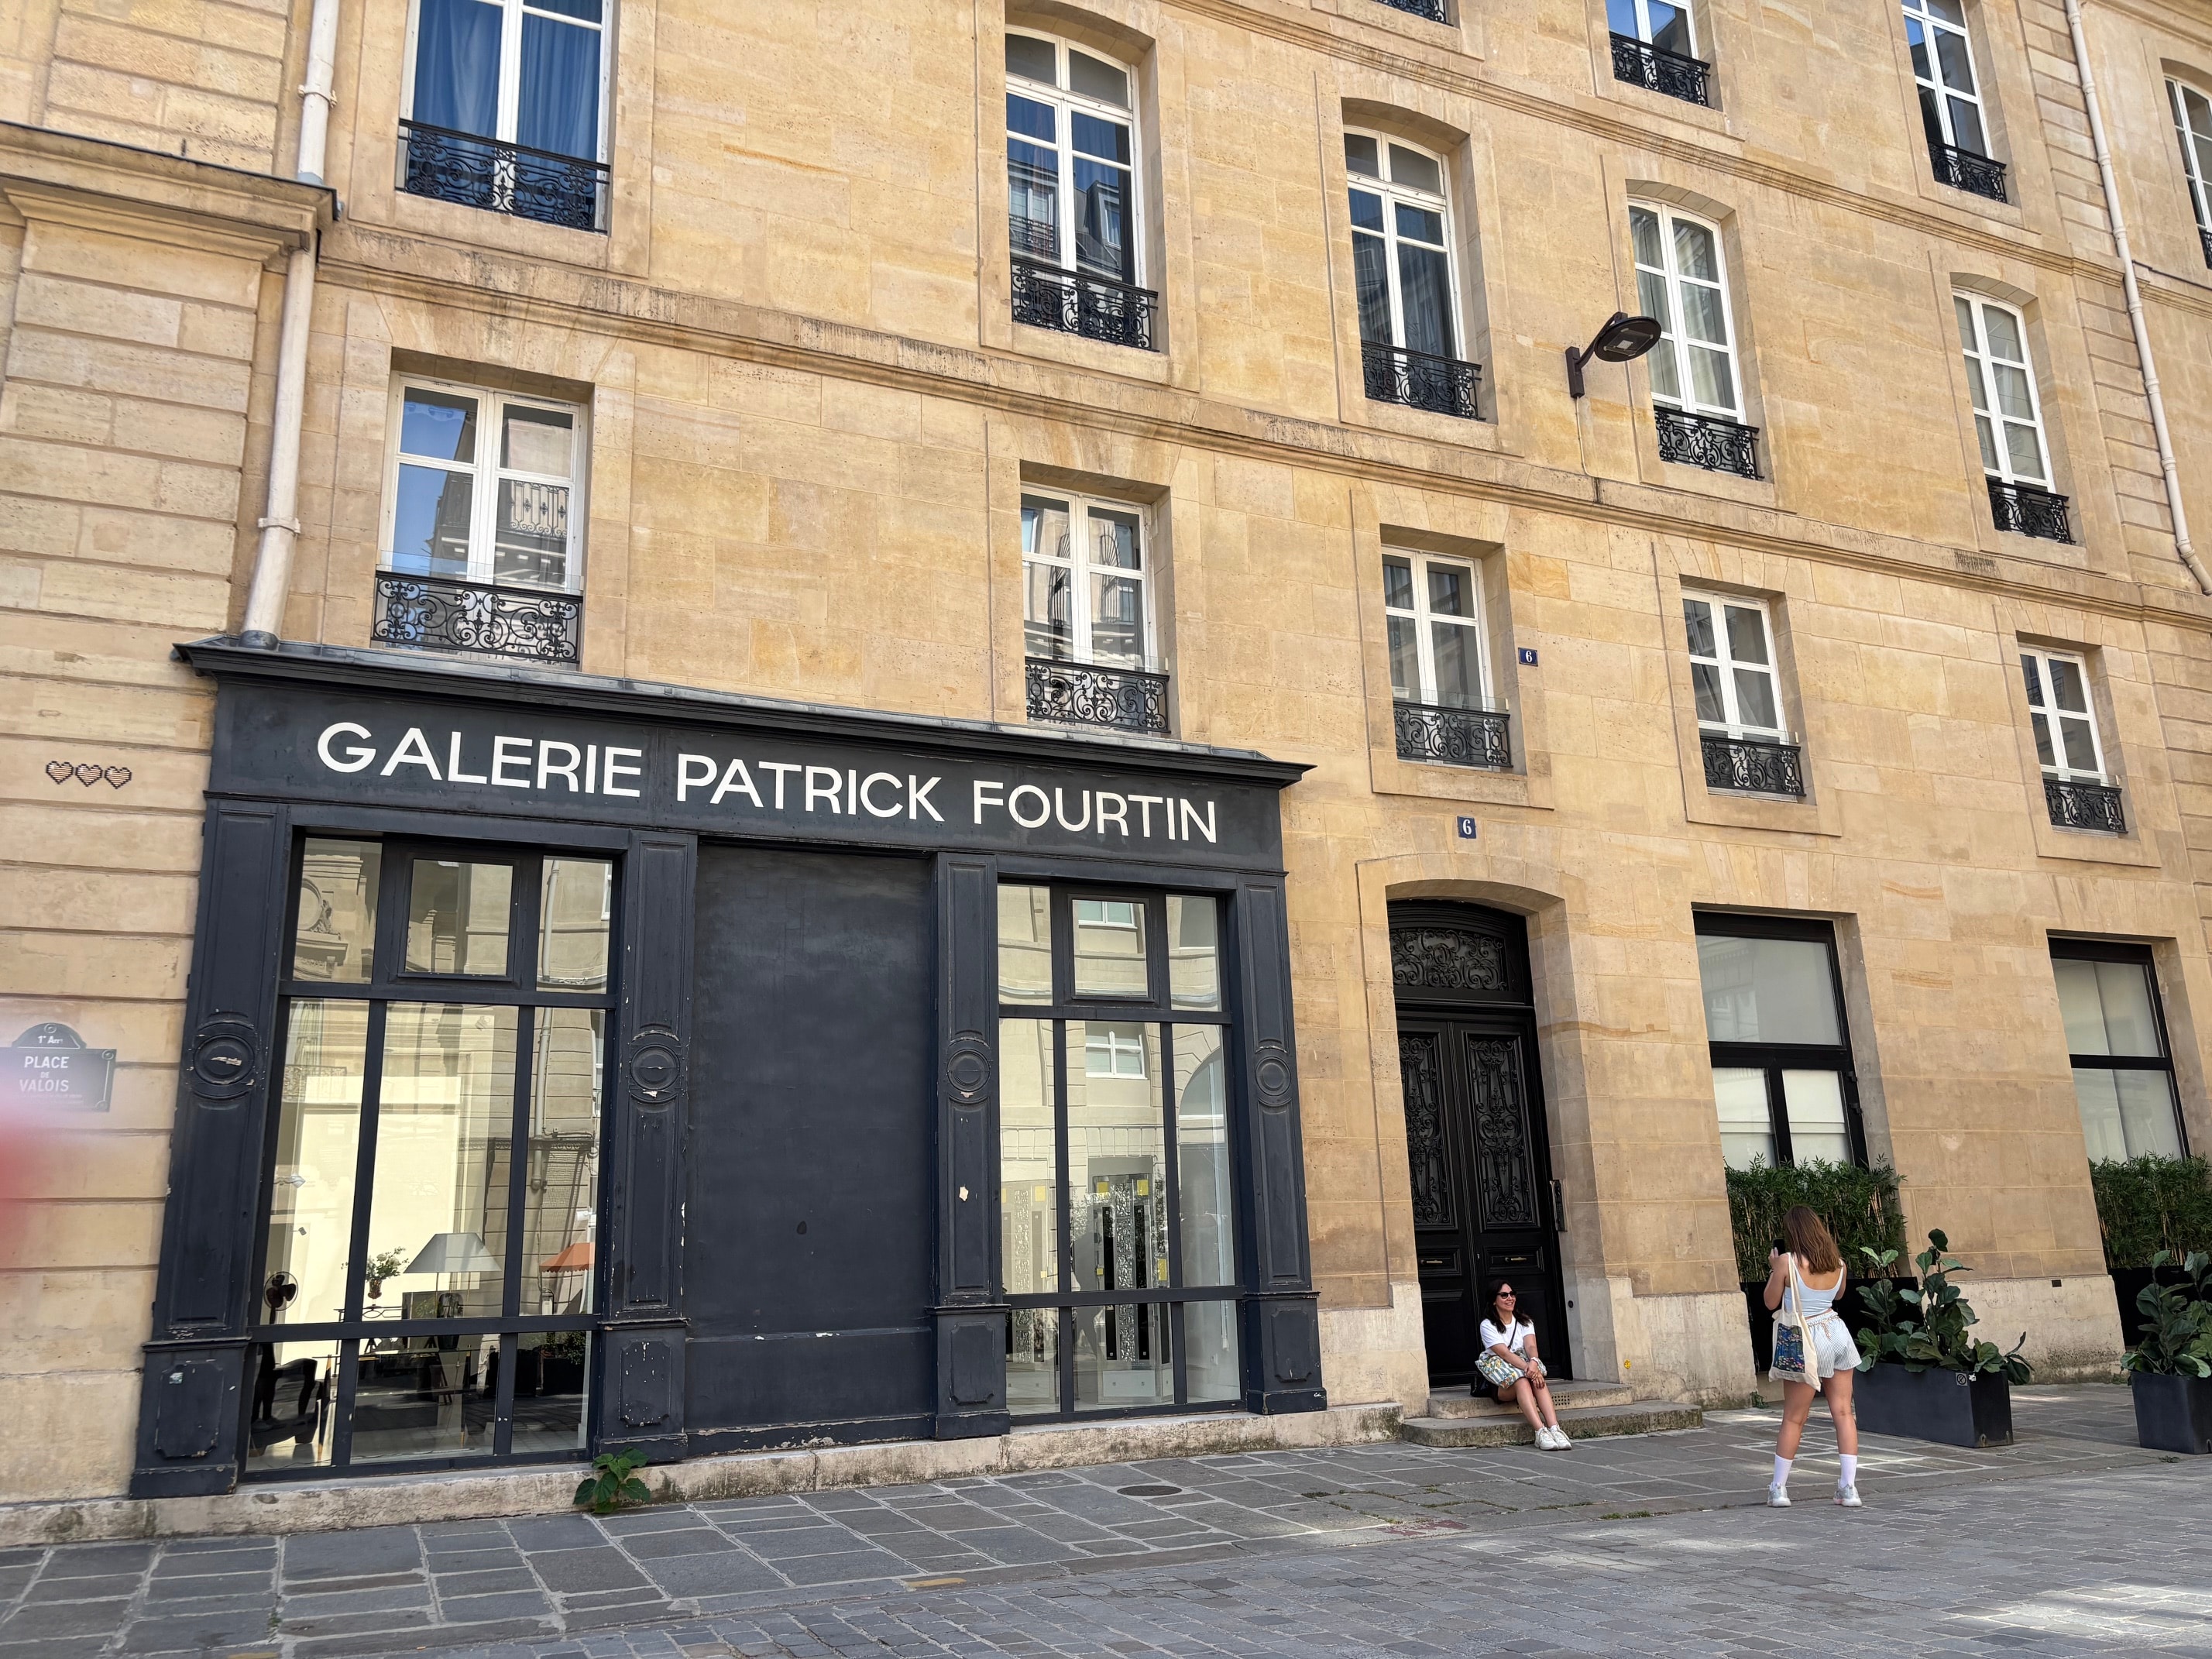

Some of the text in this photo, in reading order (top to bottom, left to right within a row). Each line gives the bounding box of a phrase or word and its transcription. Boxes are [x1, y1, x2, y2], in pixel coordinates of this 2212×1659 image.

[1525, 650, 1533, 663] 6
[318, 723, 1216, 843] GALERIE PATRICK FOURTIN
[1462, 819, 1472, 835] 6
[24, 1056, 70, 1069] PLACE
[19, 1079, 69, 1092] VALOIS
